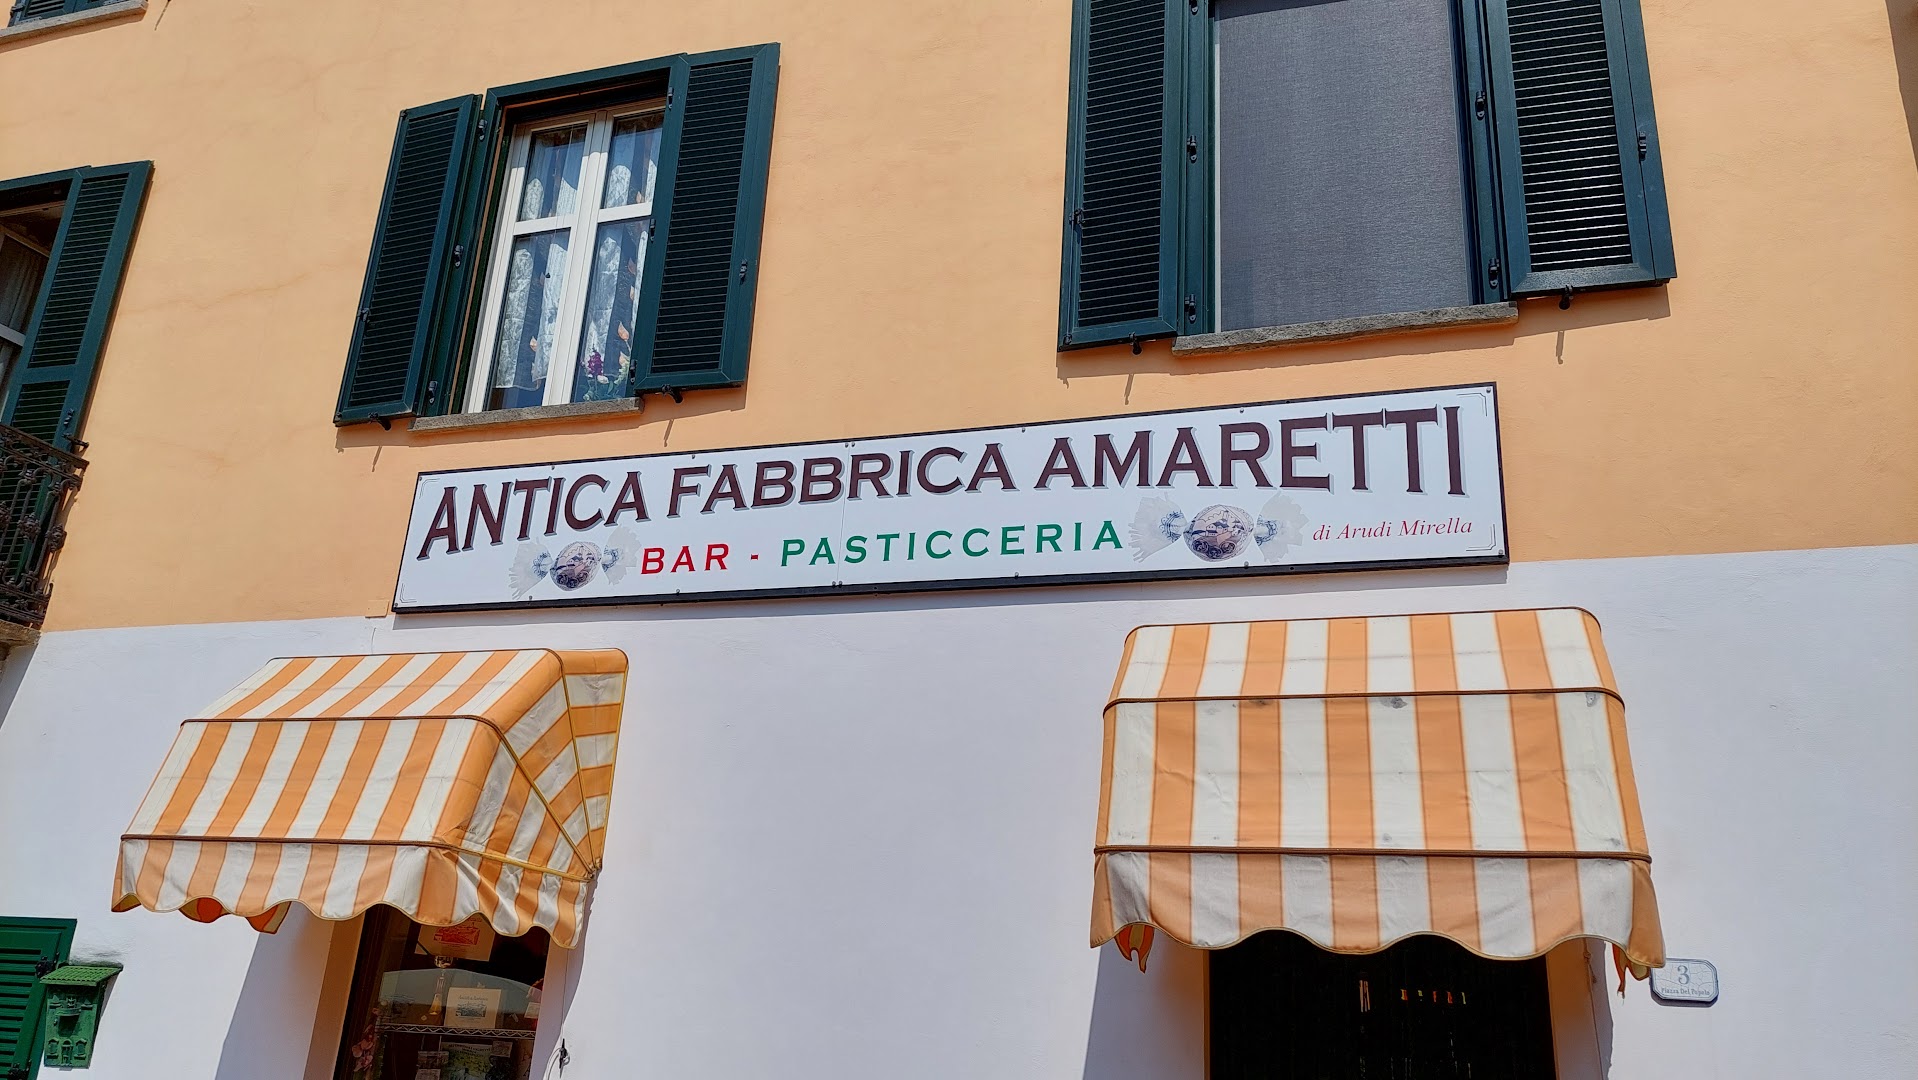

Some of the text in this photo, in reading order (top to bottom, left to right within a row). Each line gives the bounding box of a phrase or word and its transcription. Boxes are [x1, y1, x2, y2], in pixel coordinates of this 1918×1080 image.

[416, 405, 1468, 560] ANTICA FABBRICA AMARETTI
[1312, 517, 1473, 541] di Arudi Mirella
[640, 543, 730, 575] BAR
[781, 519, 1123, 568] PASTICCERIA
[1677, 965, 1690, 984] 3
[1661, 987, 1680, 995] Piazza
[1691, 988, 1710, 996] Popolo
